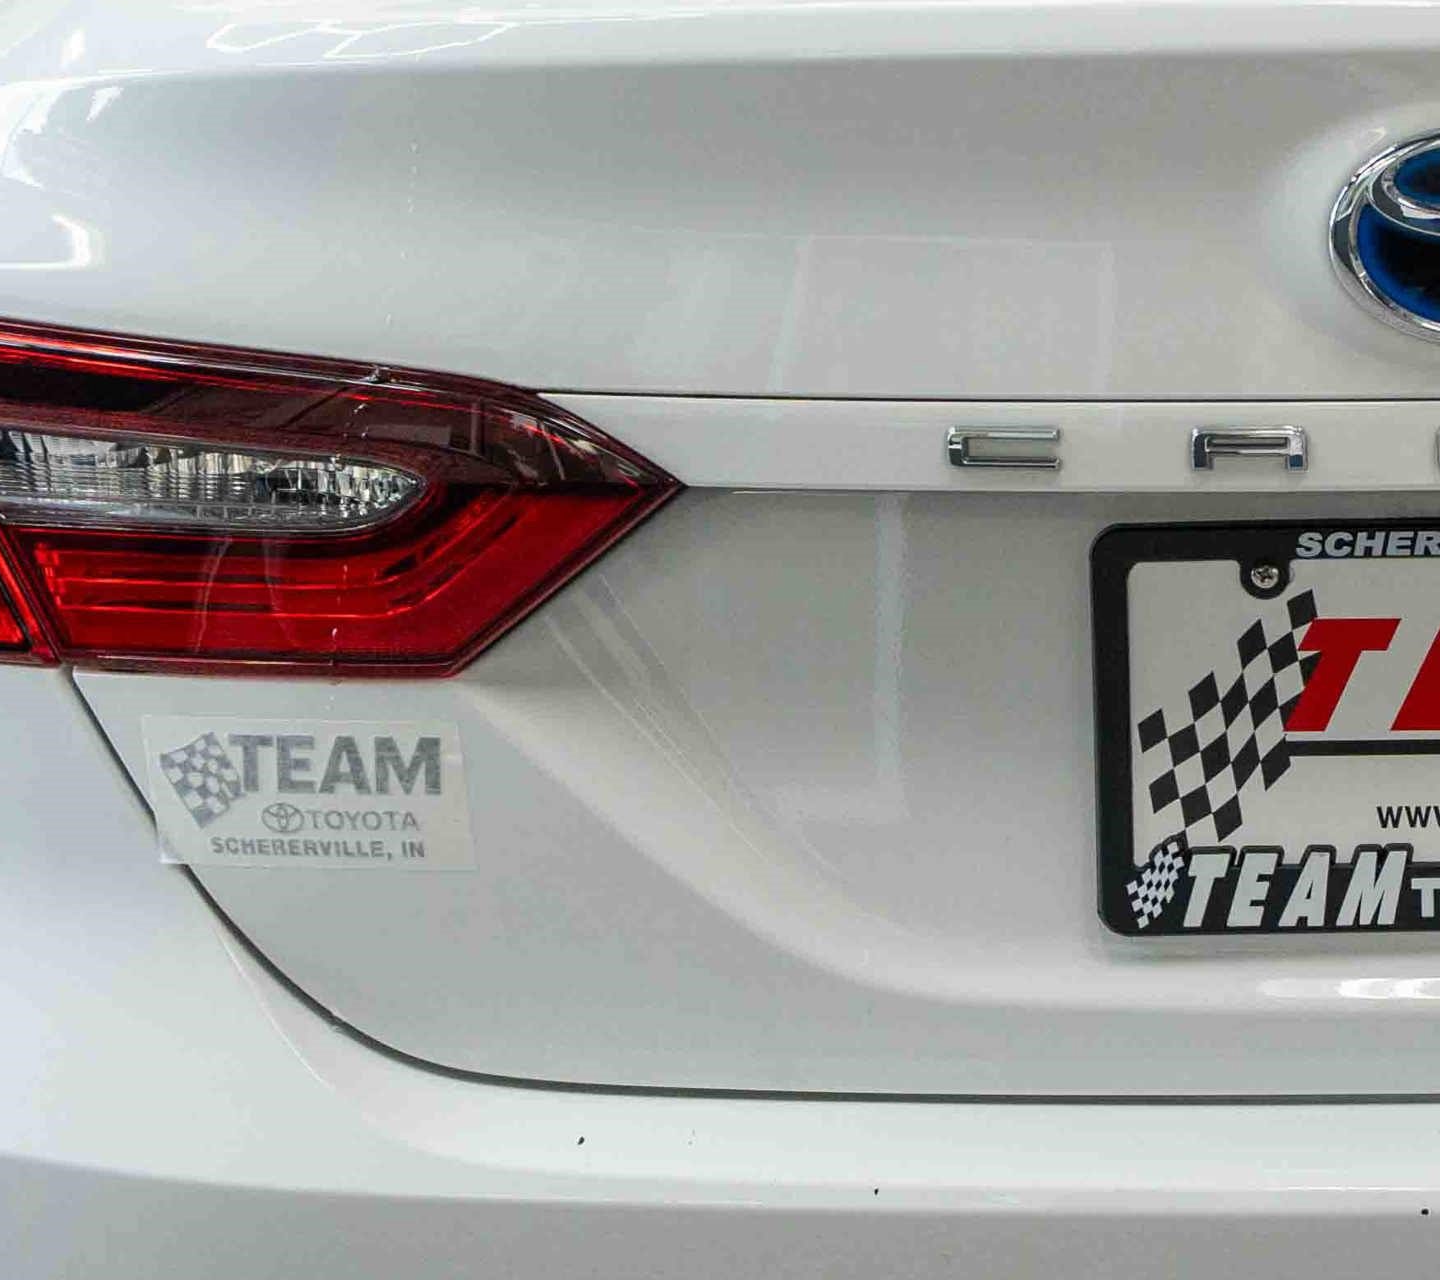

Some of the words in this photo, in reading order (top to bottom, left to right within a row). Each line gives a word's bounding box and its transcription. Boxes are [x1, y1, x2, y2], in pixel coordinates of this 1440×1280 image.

[228, 733, 441, 795] TEAM
[306, 809, 419, 831] TOYOTA
[211, 837, 393, 860] SCHERERVILLE,
[401, 840, 425, 858] IN
